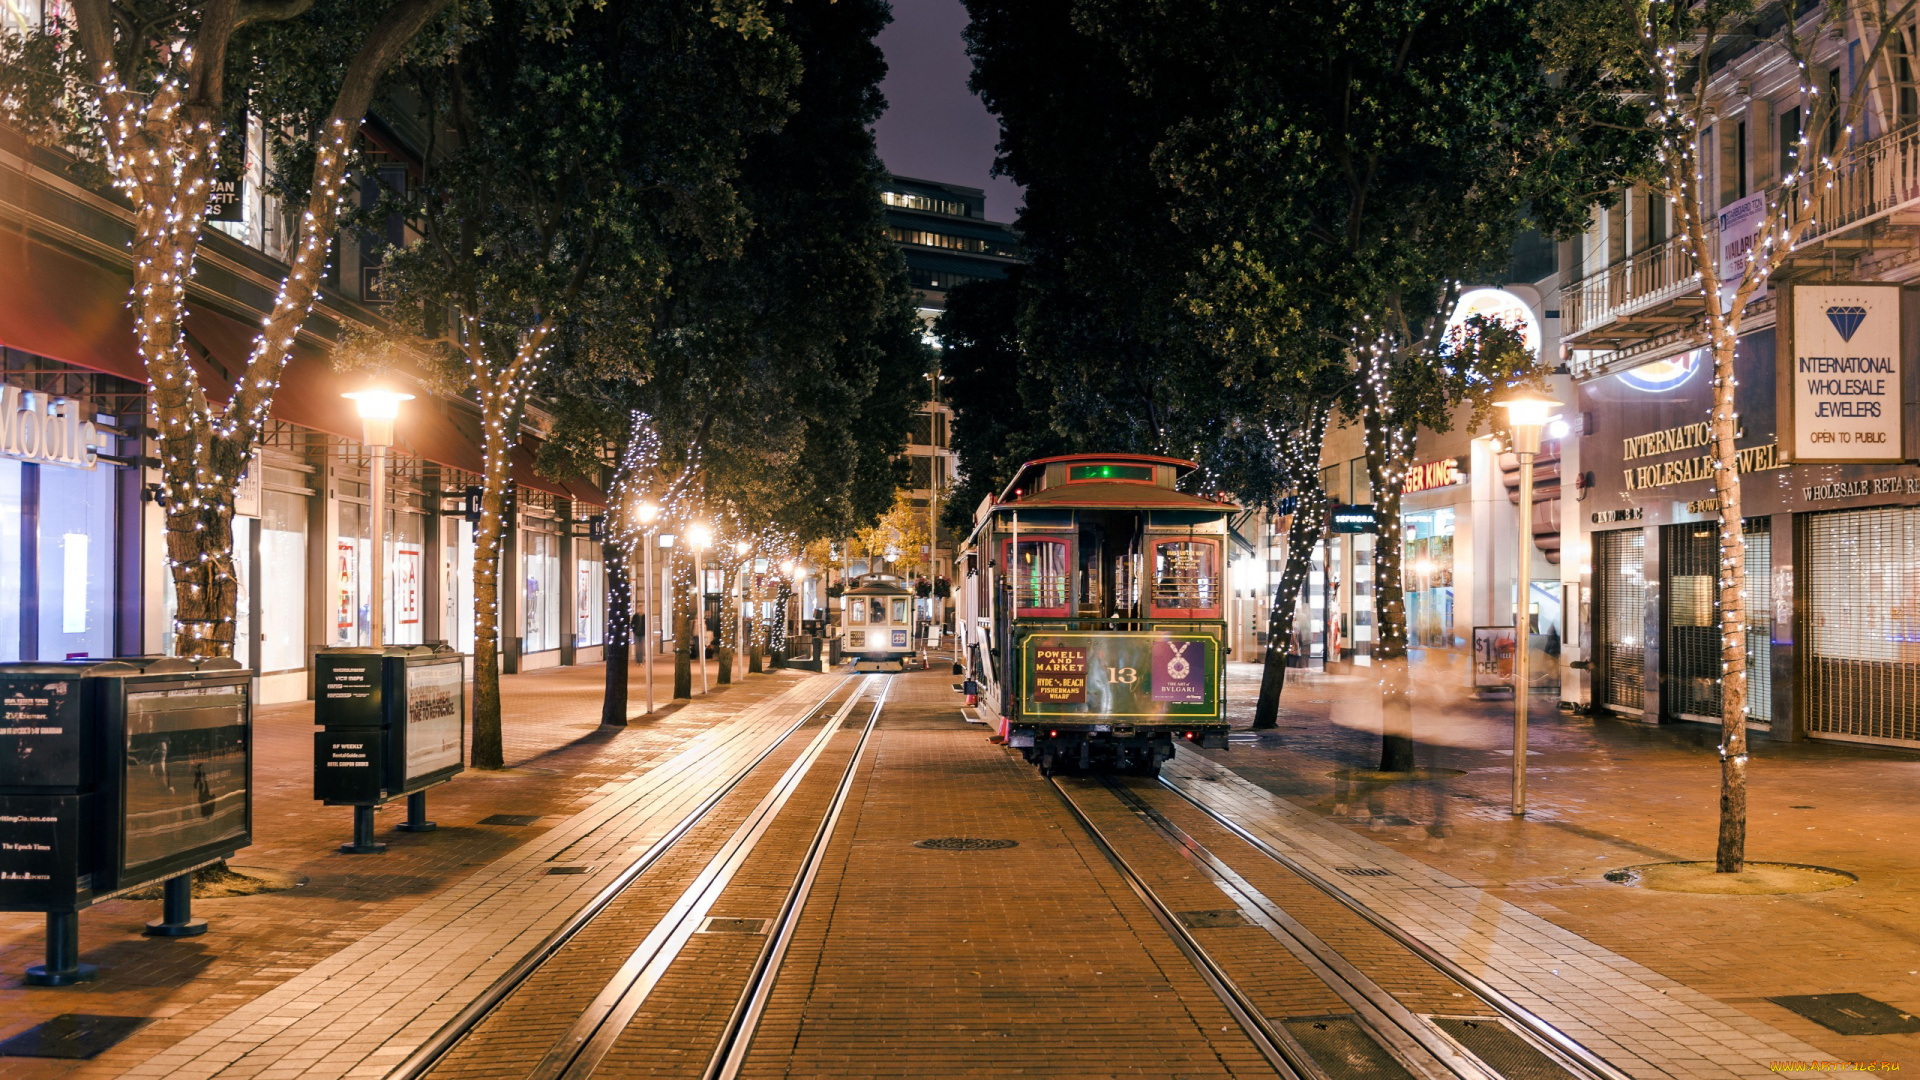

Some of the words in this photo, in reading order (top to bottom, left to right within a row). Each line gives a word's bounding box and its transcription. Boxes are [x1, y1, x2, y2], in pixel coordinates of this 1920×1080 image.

[1799, 357, 1896, 373] INTERNATIONAL
[1808, 379, 1885, 395] WHOLESALE
[1815, 402, 1881, 417] JEWELERS
[1623, 413, 1743, 461] INTERNATIOL
[1810, 432, 1835, 443] OPEN
[1838, 432, 1851, 443] TO
[1855, 432, 1886, 443] PUBLIC
[1426, 459, 1451, 489] KING
[1623, 454, 1714, 490] WHOLESALE
[1802, 480, 1869, 500] WHOLESALE
[1335, 515, 1374, 523] SEPHORA
[1037, 650, 1084, 659] POWELL
[1036, 663, 1084, 671] MARKET
[1037, 678, 1053, 686] HYDE
[1062, 678, 1084, 687] BEACH
[1107, 667, 1138, 684] 13
